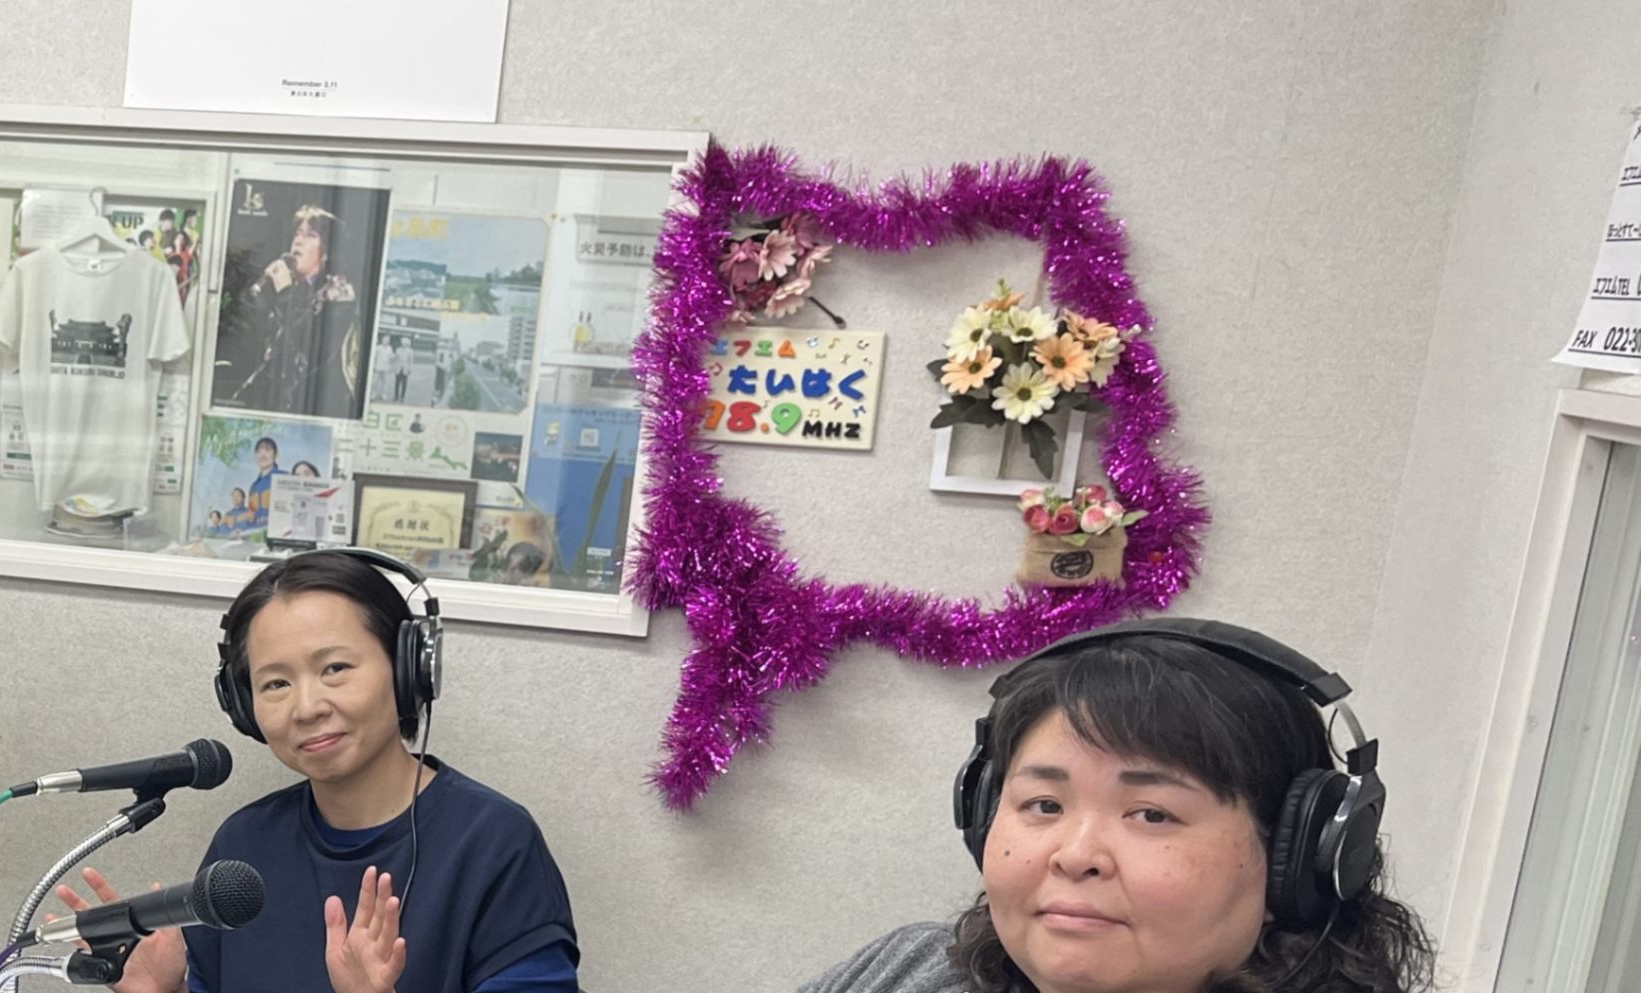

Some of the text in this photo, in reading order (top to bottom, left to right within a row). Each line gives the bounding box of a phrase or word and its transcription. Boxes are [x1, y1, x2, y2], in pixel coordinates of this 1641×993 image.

[1572, 329, 1598, 349] FAX
[727, 365, 866, 401] たいはく
[802, 420, 862, 438] MHZ
